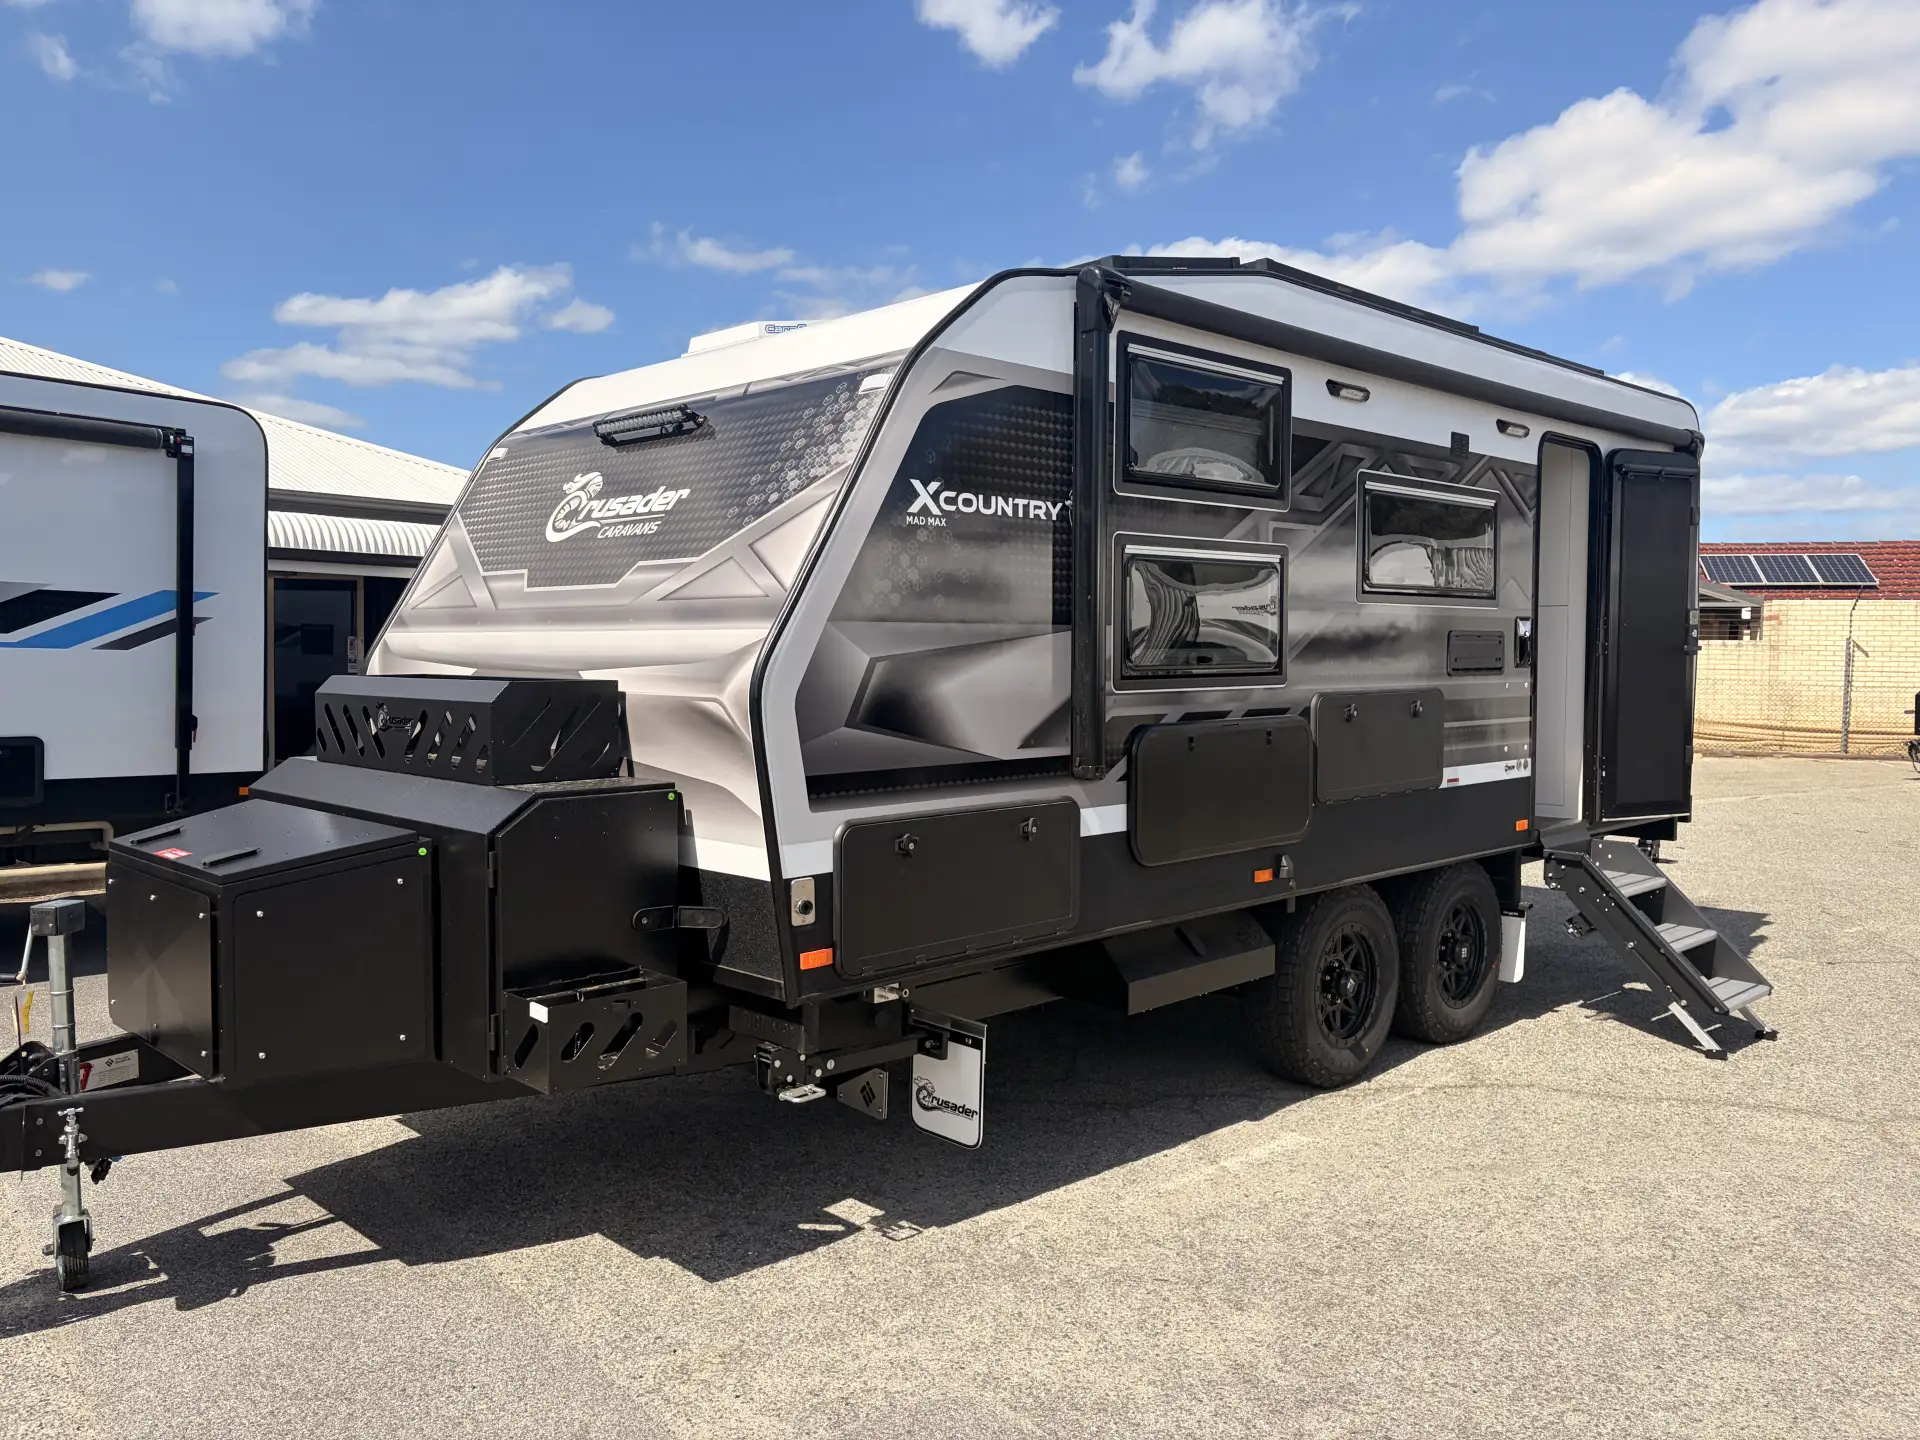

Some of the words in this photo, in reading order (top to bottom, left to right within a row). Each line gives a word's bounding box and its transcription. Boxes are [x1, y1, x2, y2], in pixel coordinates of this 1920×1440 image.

[546, 485, 691, 542] Crusader
[906, 515, 926, 526] MAD
[927, 517, 947, 527] MAX
[597, 520, 662, 539] CARAVANS
[915, 1085, 979, 1119] Crusader
